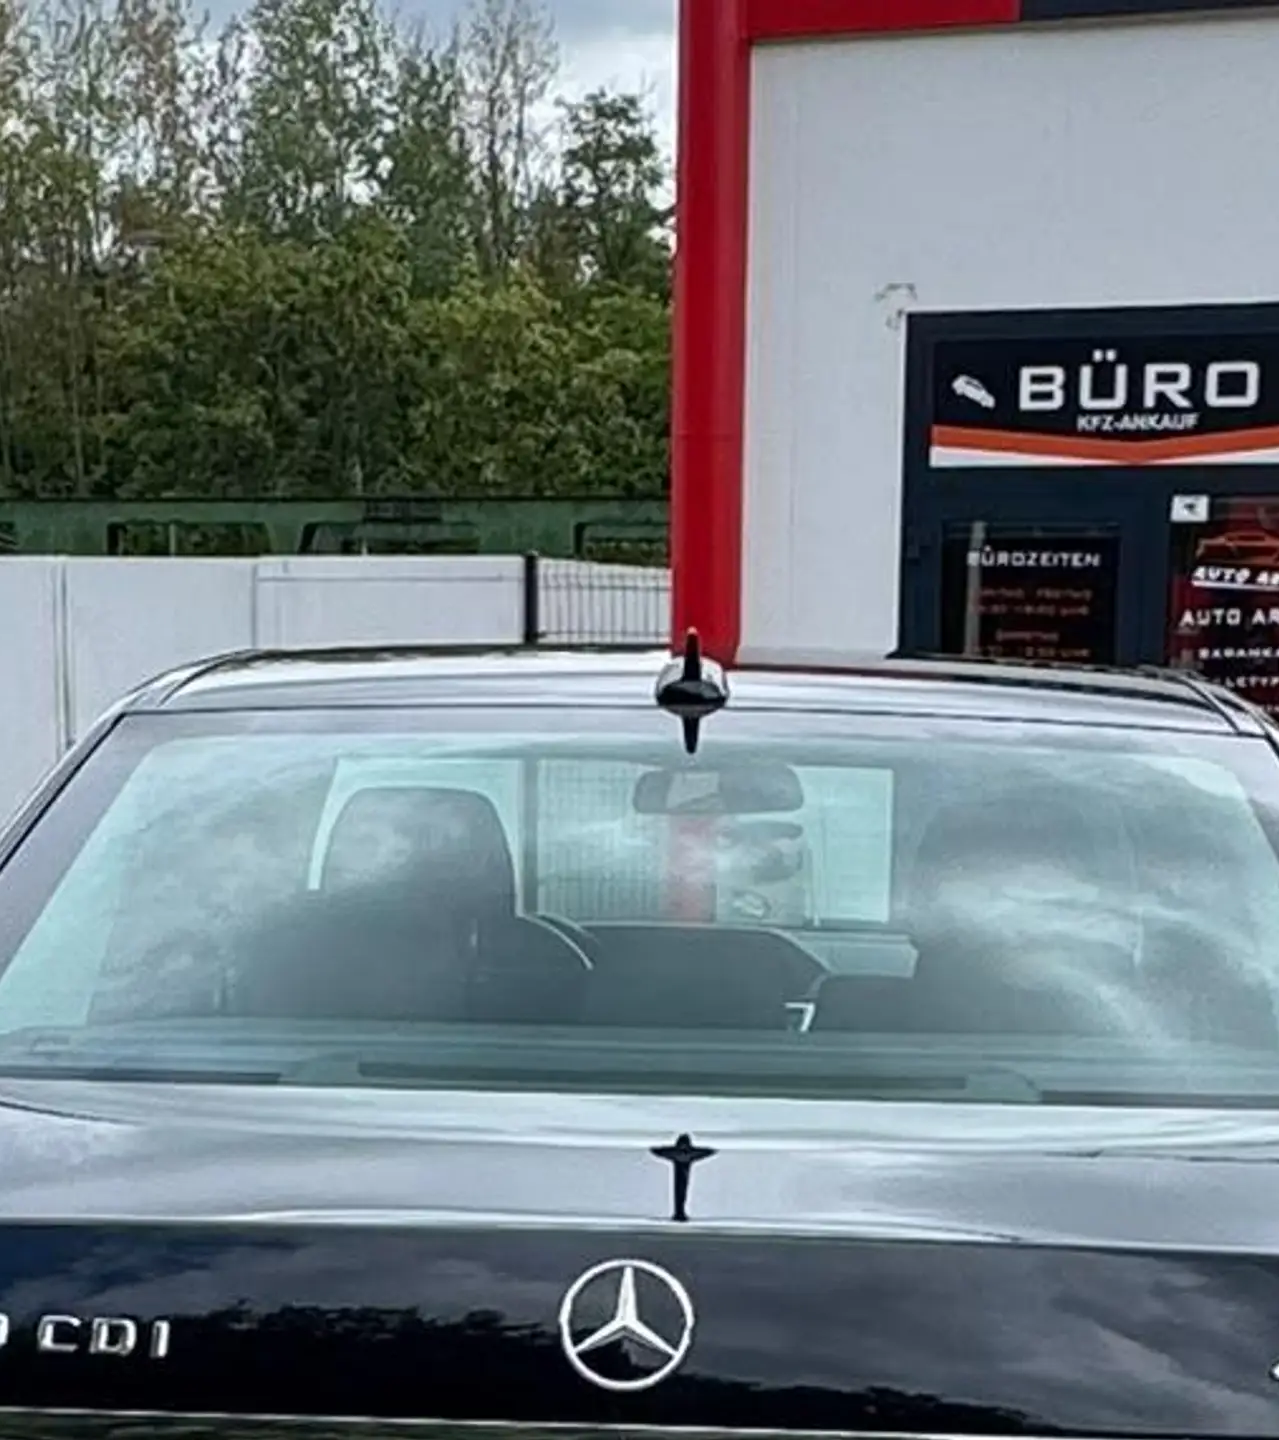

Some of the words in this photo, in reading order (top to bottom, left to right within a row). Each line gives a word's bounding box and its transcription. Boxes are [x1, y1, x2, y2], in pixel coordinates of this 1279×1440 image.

[1020, 350, 1261, 411] BÜRO
[1077, 413, 1201, 432] KFZ-ANKAUF
[966, 545, 1102, 567] BÜROZEITEN
[1179, 608, 1242, 627] AUTO
[36, 1314, 172, 1358] CDI
